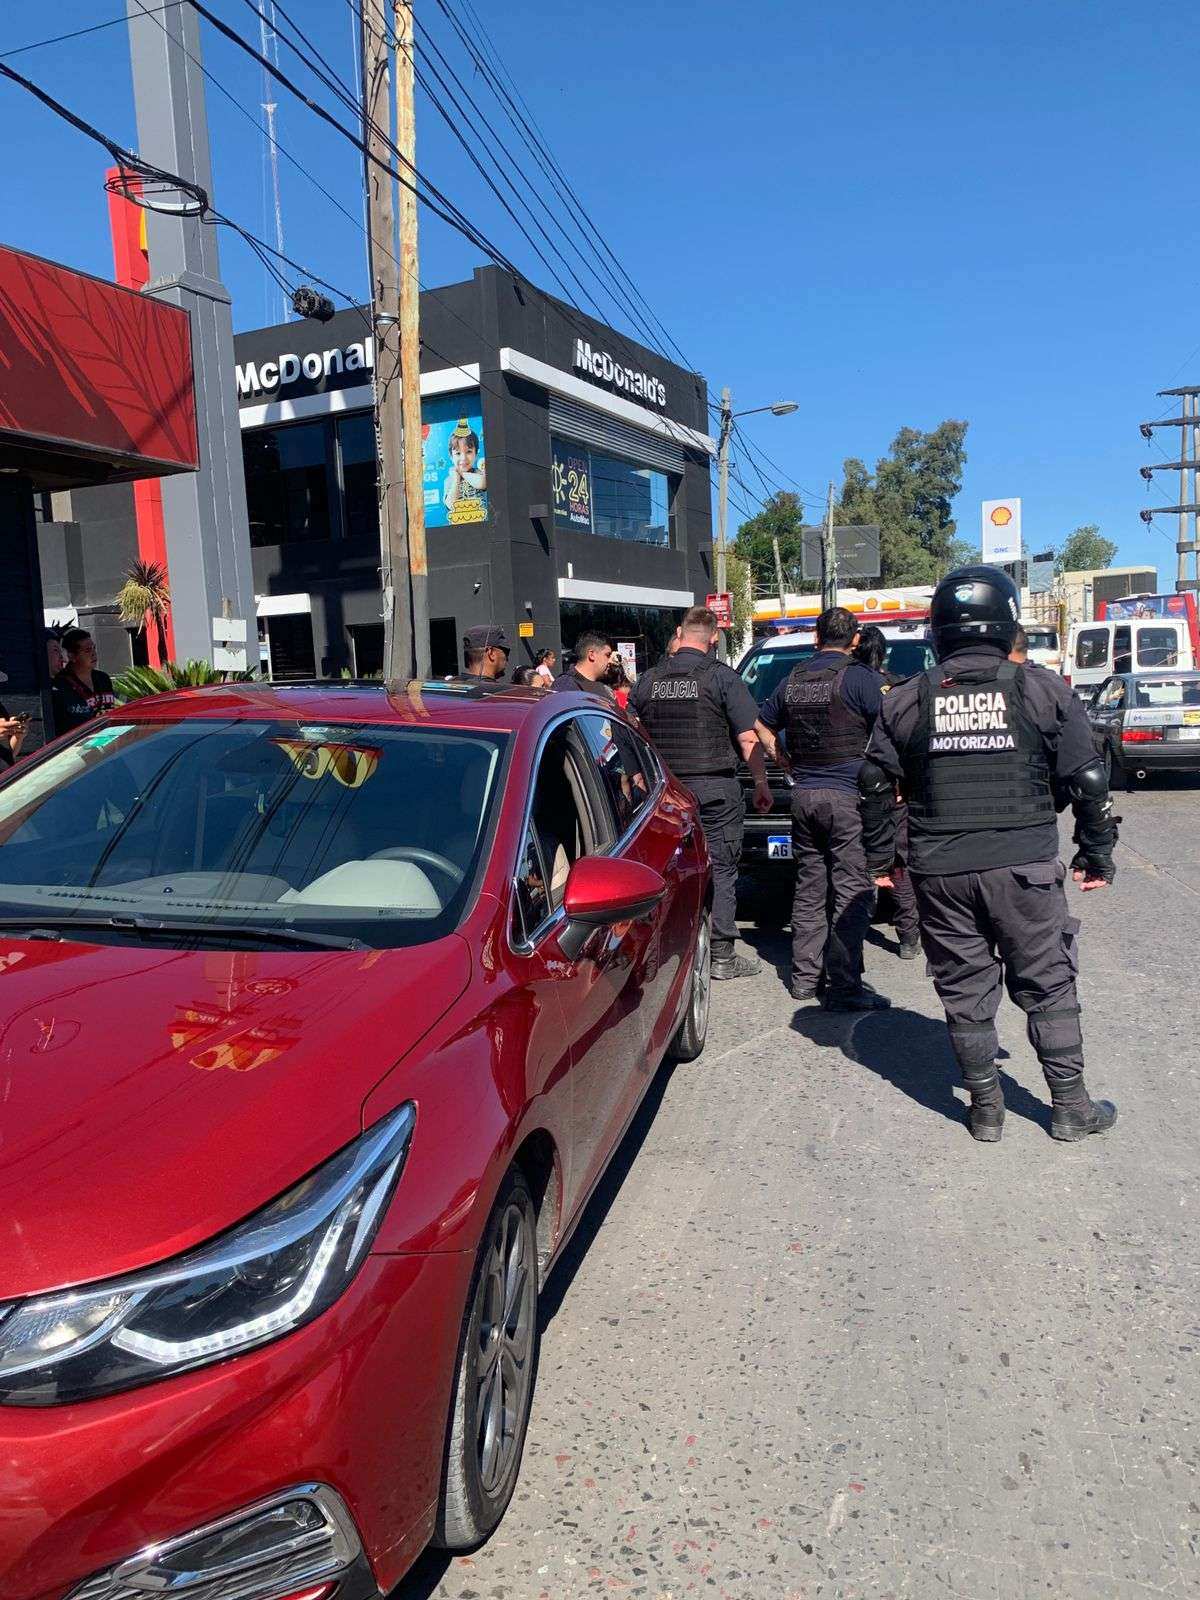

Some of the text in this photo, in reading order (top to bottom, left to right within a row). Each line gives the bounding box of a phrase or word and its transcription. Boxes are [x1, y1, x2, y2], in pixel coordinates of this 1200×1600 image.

[234, 336, 375, 393] McDonal
[576, 338, 667, 407] McDonald's
[567, 470, 589, 505] 24
[651, 680, 699, 699] POLICIA
[784, 683, 831, 703] POLICIA
[934, 692, 1007, 715] POLICIA
[934, 711, 1008, 733] MUNICIPAL
[932, 735, 1015, 750] MOTORIZADA
